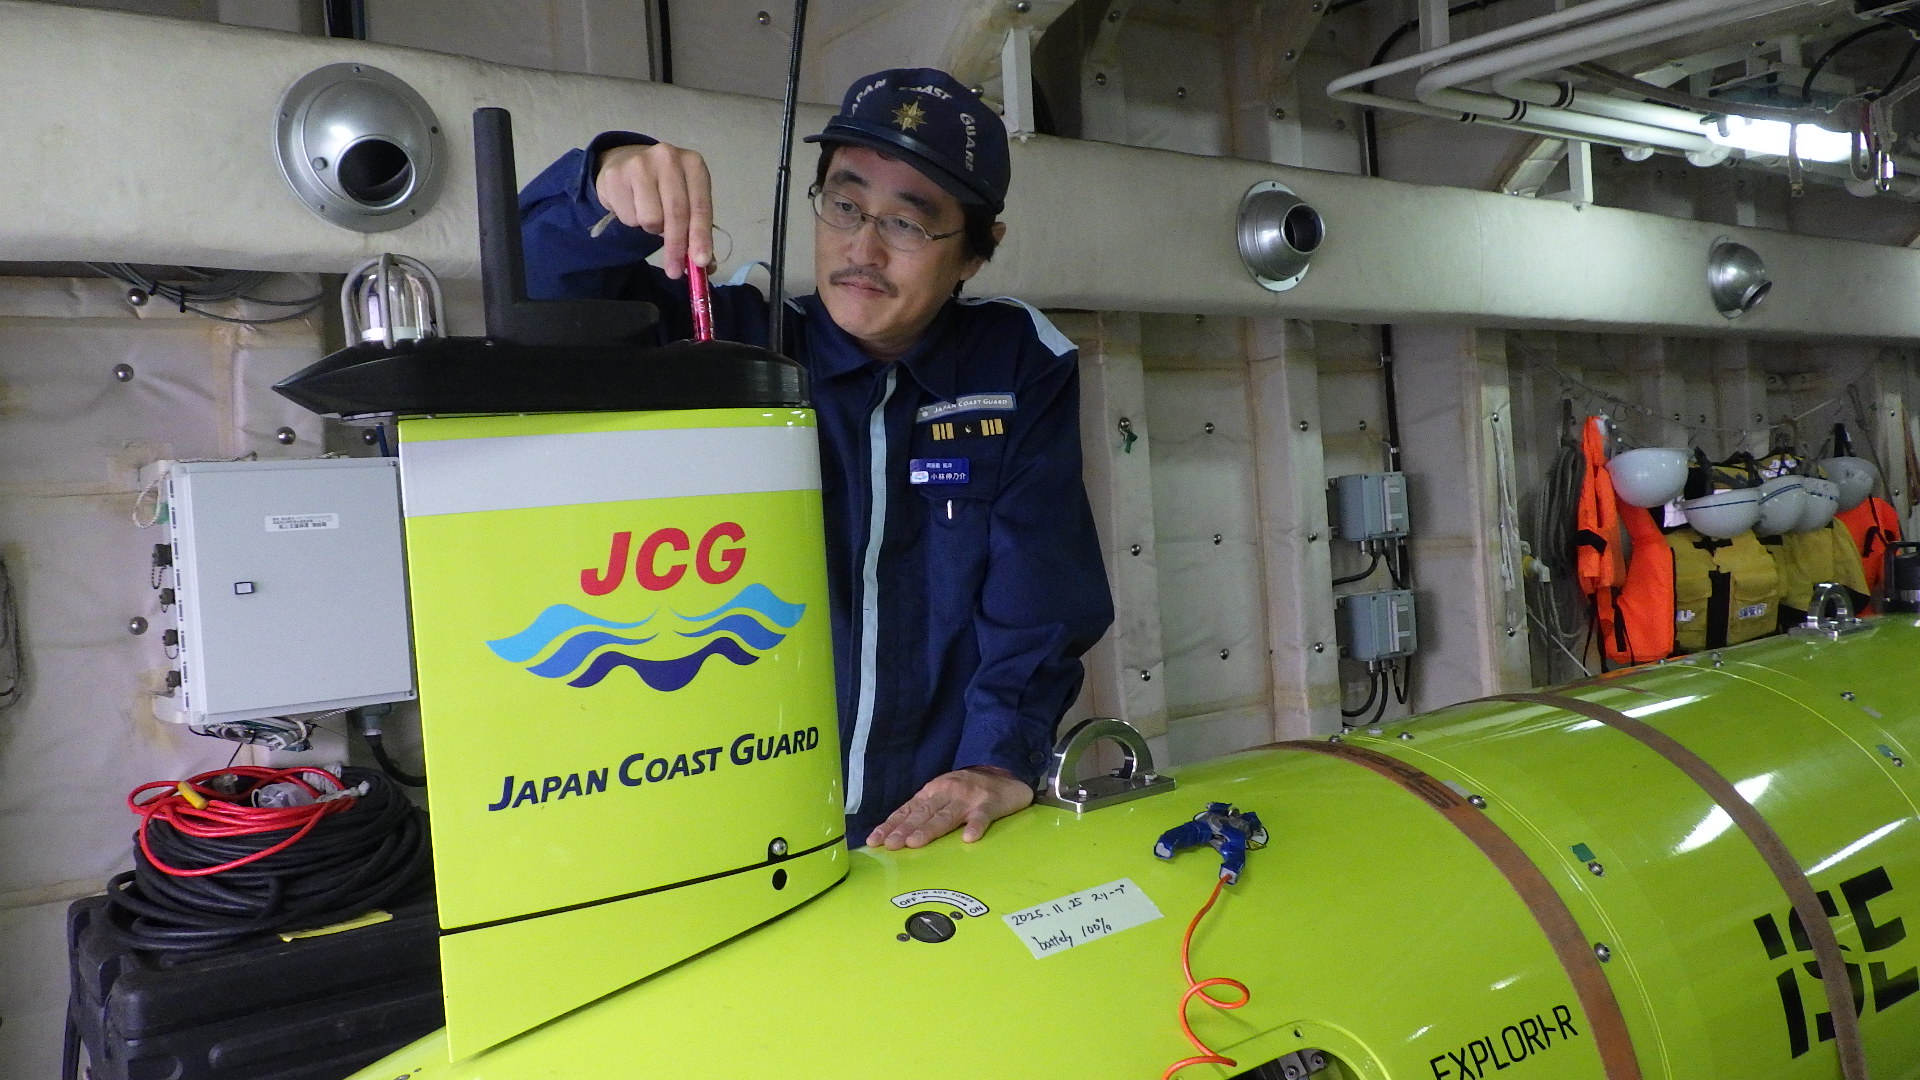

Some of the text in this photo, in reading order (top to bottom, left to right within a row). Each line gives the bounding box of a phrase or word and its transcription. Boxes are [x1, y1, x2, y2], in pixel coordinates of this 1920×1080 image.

[851, 78, 887, 116] APAN
[898, 84, 953, 100] AST
[934, 402, 957, 413] JAPAN
[958, 399, 981, 407] COAST
[580, 522, 747, 596] JCG
[488, 726, 819, 812] JAPAN COAST GUARD
[899, 896, 917, 906] OFF
[969, 905, 984, 914] ON
[1081, 917, 1112, 938] 100%
